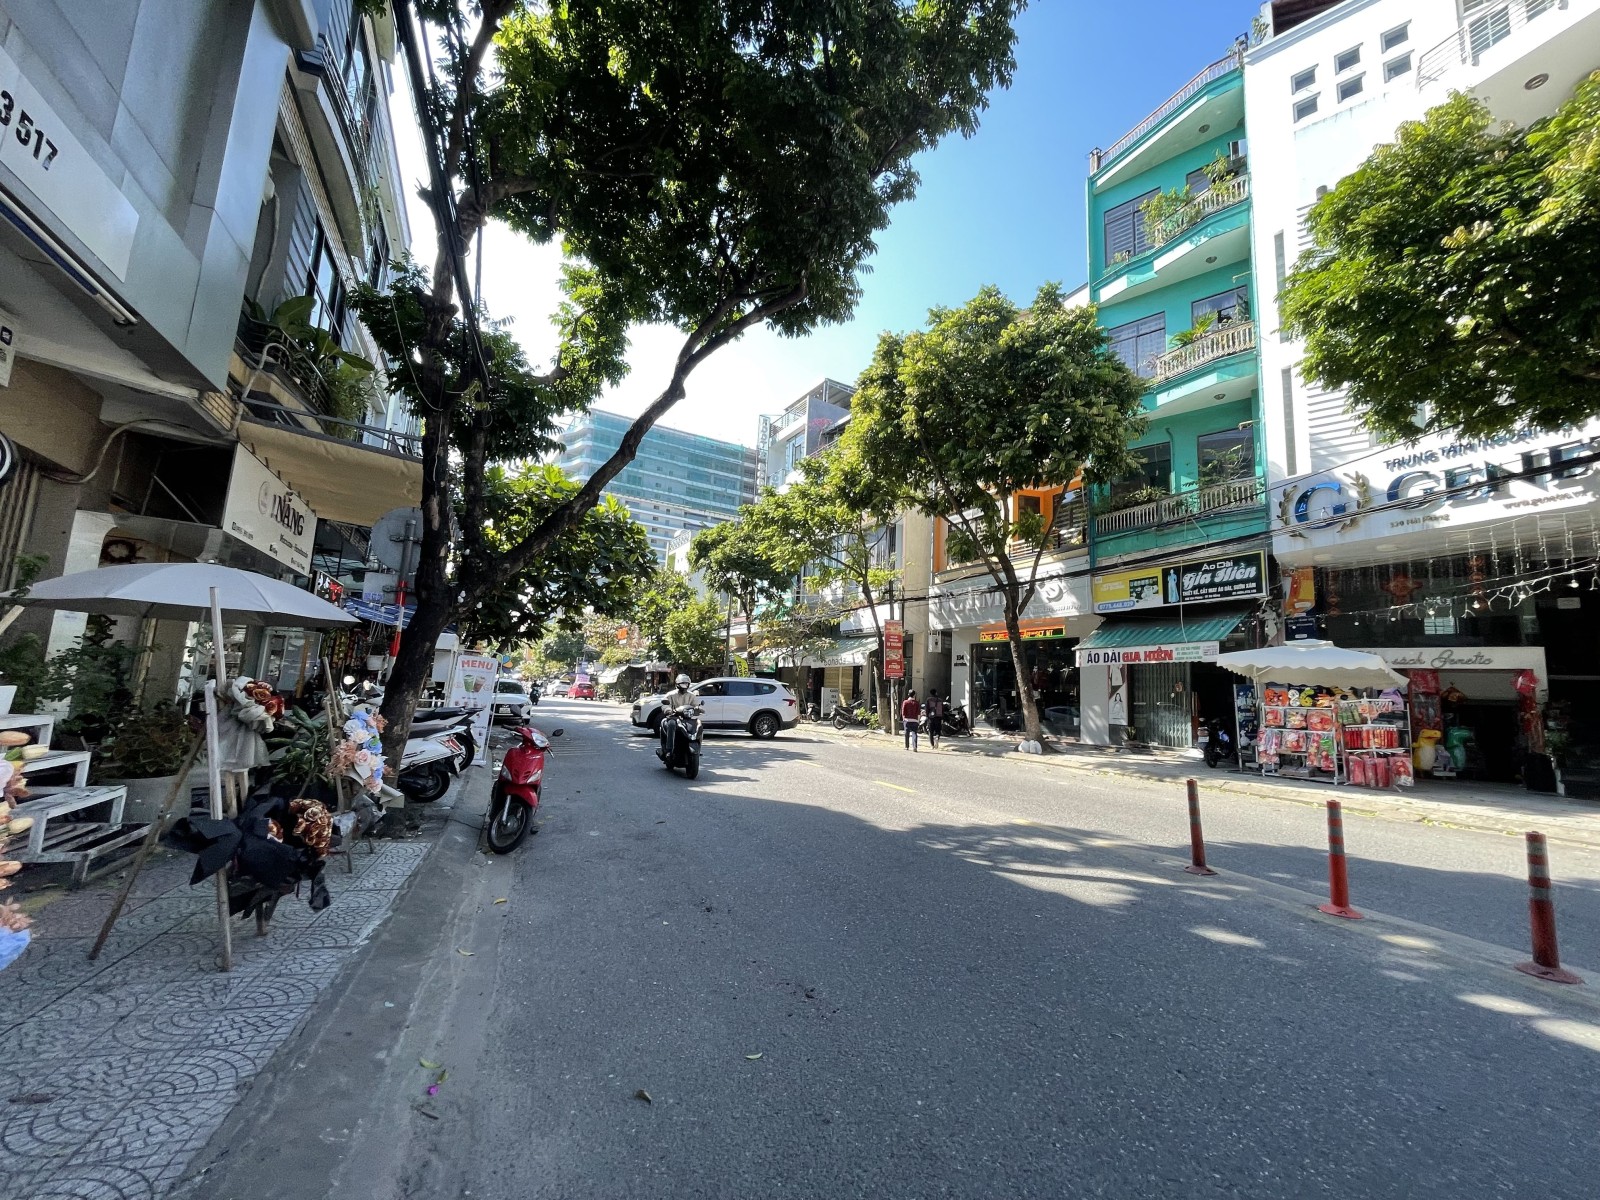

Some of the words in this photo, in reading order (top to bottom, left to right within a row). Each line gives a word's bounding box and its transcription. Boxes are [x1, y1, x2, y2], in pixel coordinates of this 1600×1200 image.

[1384, 450, 1438, 471] TRUNG
[1295, 482, 1346, 529] G
[461, 660, 493, 670] MENU
[1087, 651, 1100, 663] ÁO
[1103, 650, 1120, 663] DÀI
[1122, 651, 1141, 662] GIA
[1431, 649, 1493, 669] Genetic
